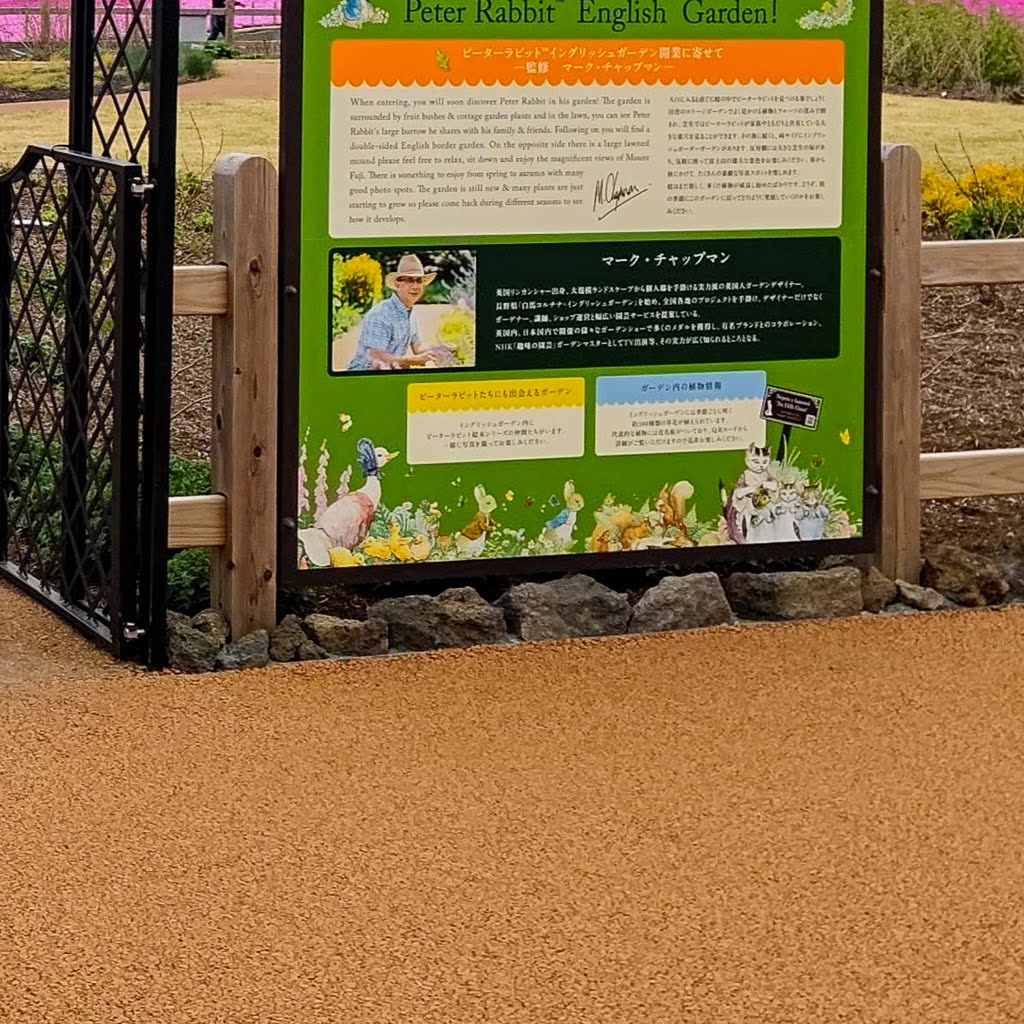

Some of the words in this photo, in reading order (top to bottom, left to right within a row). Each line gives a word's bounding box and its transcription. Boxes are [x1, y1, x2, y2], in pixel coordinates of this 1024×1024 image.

[350, 98, 374, 106] When
[413, 100, 426, 108] you
[429, 97, 444, 106] will
[466, 97, 496, 105] discover
[500, 97, 519, 105] Peter
[521, 97, 546, 105] Rabbit
[558, 97, 570, 105] his
[602, 97, 615, 105] The
[617, 96, 642, 107] garden
[350, 113, 391, 121] surrounded
[392, 113, 401, 123] by
[403, 112, 420, 121] fruit
[422, 112, 445, 120] bushes
[447, 112, 455, 120] &
[457, 113, 482, 123] cottage
[484, 112, 509, 122] garden
[510, 112, 531, 122] plants
[533, 112, 546, 120] and
[548, 112, 556, 120] in
[558, 111, 569, 119] the
[592, 113, 604, 122] you
[633, 111, 650, 119] Peter
[401, 127, 426, 135] burrow
[428, 127, 437, 135] he
[439, 127, 461, 135] shares
[463, 127, 479, 135] with
[481, 127, 492, 135] his
[493, 127, 515, 137] family
[517, 126, 525, 135] &
[554, 126, 589, 137] Following
[601, 128, 614, 136] you
[616, 126, 629, 134] will
[630, 126, 644, 134] find
[349, 142, 398, 150] double-sided
[401, 142, 430, 152] English
[432, 141, 456, 149] border
[488, 141, 501, 149] On
[503, 141, 516, 149] the
[518, 141, 548, 151] opposite
[551, 140, 565, 149] side
[568, 140, 587, 148] there
[624, 140, 650, 148] lawned
[377, 156, 400, 167] please
[402, 156, 416, 164] feel
[418, 156, 432, 164] free
[500, 155, 513, 163] and
[516, 157, 534, 165] enjoy
[536, 155, 548, 163] the
[616, 154, 624, 162] of
[625, 154, 650, 162] Mount
[368, 171, 388, 179] There
[390, 171, 396, 179] is
[398, 170, 435, 181] something
[446, 172, 465, 181] enjoy
[466, 170, 484, 178] from
[486, 170, 508, 180] spring
[547, 169, 563, 177] with
[565, 171, 584, 179] many
[349, 185, 367, 196] good
[370, 185, 391, 196] photo
[417, 185, 430, 193] The
[433, 184, 458, 195] garden
[468, 184, 483, 192] still
[502, 184, 510, 192] &
[511, 186, 531, 194] many
[533, 183, 555, 194] plants
[570, 184, 583, 194] just
[349, 201, 377, 211] starting
[388, 202, 406, 210] grow
[418, 200, 439, 210] please
[462, 199, 478, 207] back
[480, 199, 503, 209] during
[505, 199, 534, 207] different
[349, 215, 364, 223] how
[366, 215, 372, 223] it
[601, 251, 731, 268] マーク・チャップマン
[641, 381, 722, 392] ガーデン内の植物情報
